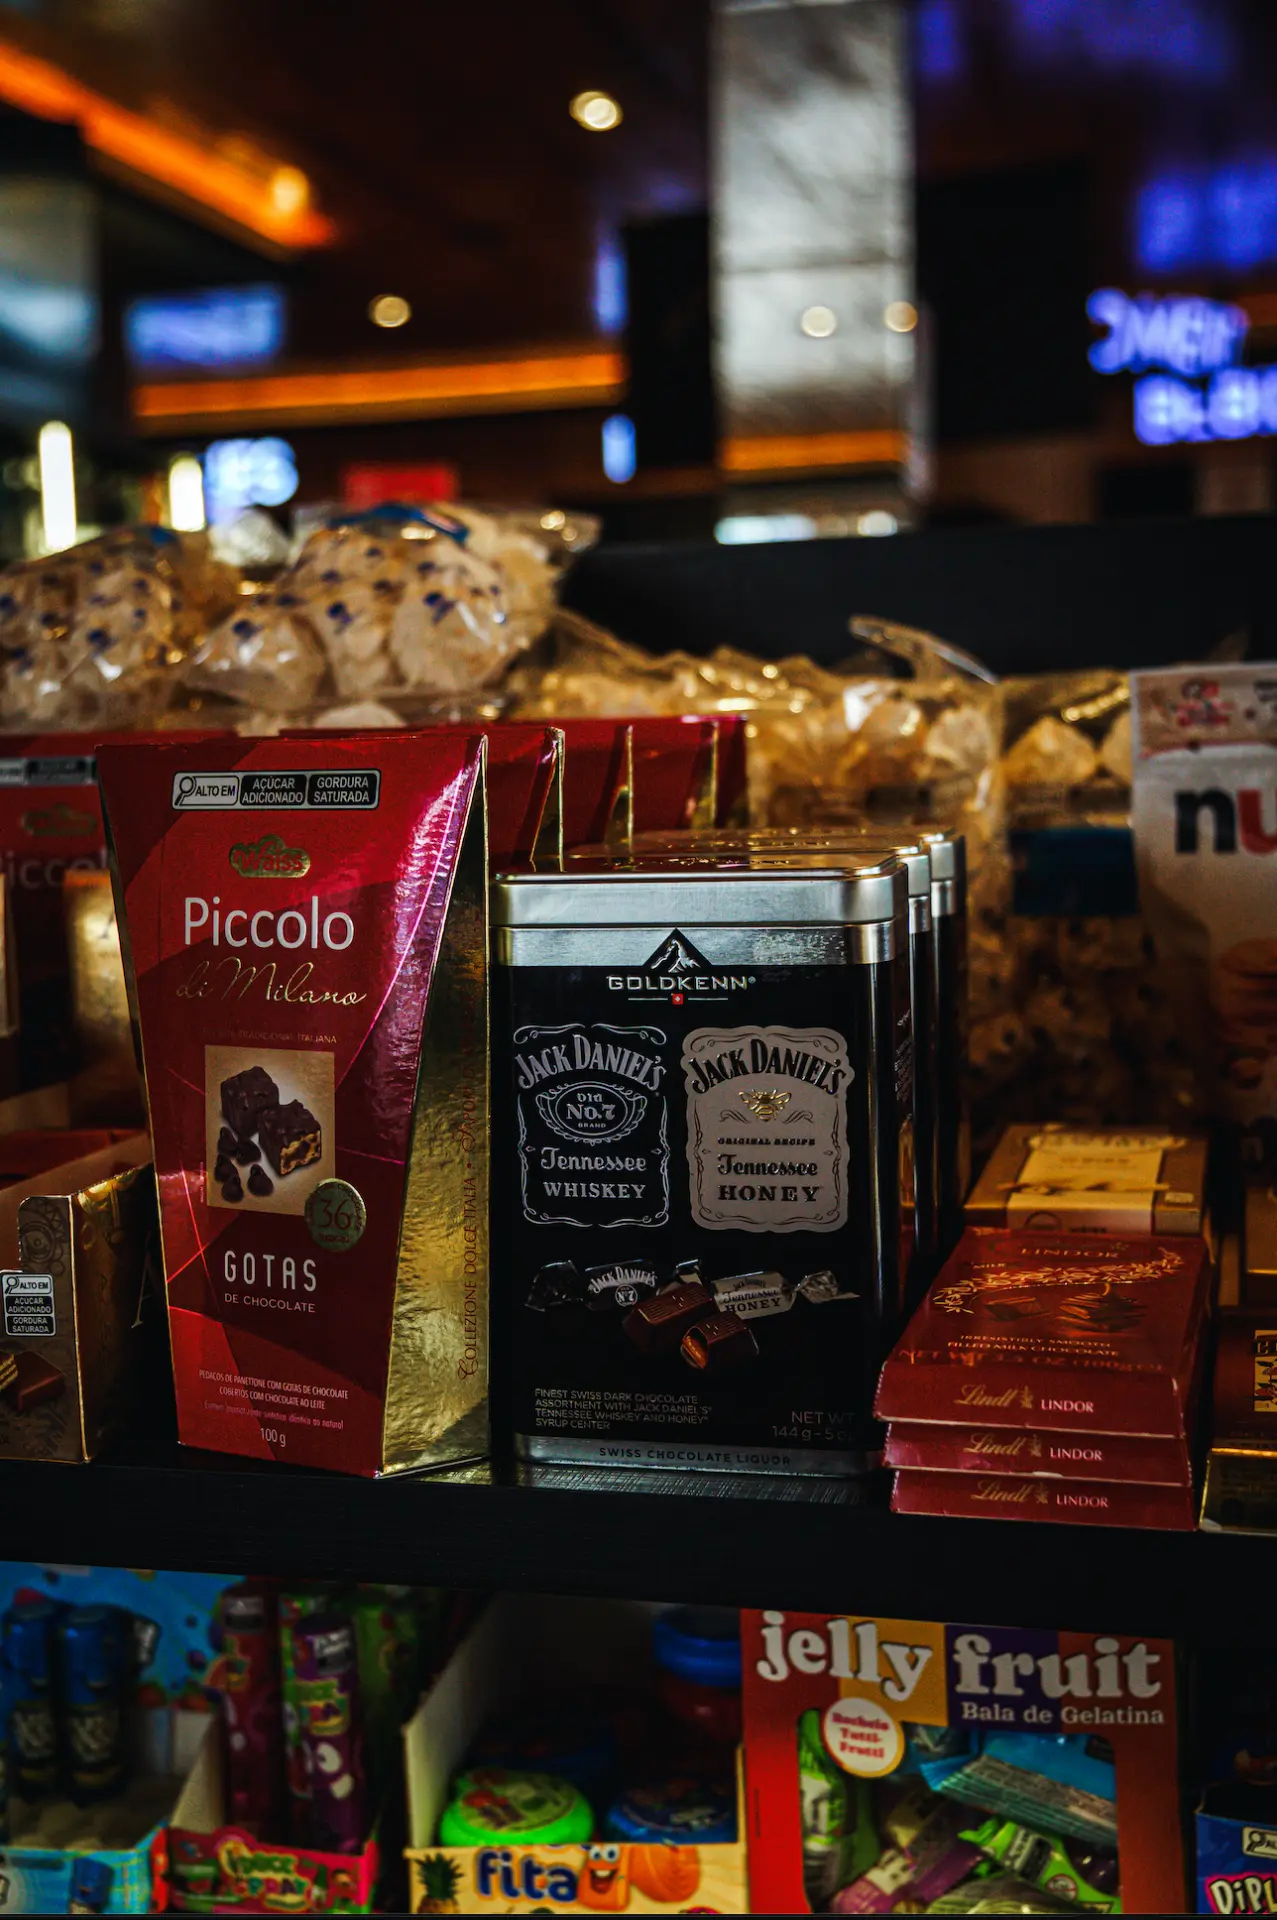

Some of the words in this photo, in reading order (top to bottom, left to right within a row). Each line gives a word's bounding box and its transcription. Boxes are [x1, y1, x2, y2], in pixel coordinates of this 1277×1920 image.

[195, 786, 219, 796] ALTO
[221, 785, 235, 796] EM
[253, 775, 295, 792] AÇÚCAR
[317, 776, 369, 789] GORDURA
[242, 792, 304, 803] ADICIONADO
[313, 791, 369, 803] SATURADA
[232, 840, 302, 872] Waiss
[184, 895, 354, 950] Piccolo
[176, 960, 214, 999] di
[217, 956, 367, 1005] Milano
[297, 1032, 337, 1044] ITALIANA
[514, 1044, 574, 1089] JACK
[572, 1033, 667, 1093] DANIEL'S
[688, 1048, 750, 1094] JACK
[750, 1038, 846, 1095] DANIEL'S
[718, 1138, 771, 1146] ORIGINAL
[774, 1138, 816, 1146] RECIPE
[540, 1147, 647, 1171] Tennessee
[717, 1154, 818, 1176] Tennessee
[463, 1177, 477, 1222] ITALIA
[543, 1182, 646, 1199] WHISKEY
[718, 1185, 821, 1202] HONEY
[318, 1198, 351, 1230] 36
[463, 1225, 478, 1279] DOLCE
[224, 1250, 317, 1292] GOTAS
[19, 1282, 37, 1290] ALTO
[38, 1281, 49, 1290] EM
[8, 1305, 52, 1314] ADICIONADO
[224, 1293, 239, 1304] DE
[243, 1295, 316, 1314] CHOCOLATE
[724, 1297, 782, 1314] HONEY
[12, 1325, 50, 1333] SATURADA
[13, 1316, 48, 1325] GORDURA
[458, 1285, 479, 1381] COLLEZIONE
[225, 1374, 233, 1383] DE
[234, 1375, 266, 1389] PANETTONE
[267, 1380, 282, 1391] COM
[283, 1382, 302, 1394] GOTAS
[303, 1385, 311, 1394] DE
[312, 1386, 349, 1400] CHOCOLATE
[535, 1388, 568, 1398] FINEST
[571, 1390, 602, 1400] SWISS
[604, 1391, 632, 1401] DARK
[635, 1393, 698, 1405] CHOCOLATE
[219, 1386, 249, 1399] COBERTOS
[250, 1390, 264, 1401] COM
[265, 1392, 299, 1406] CHOCOLATE
[300, 1397, 309, 1407] AO
[310, 1399, 325, 1410] LEITE
[535, 1399, 602, 1410] ASSORTMENT
[604, 1401, 631, 1411] WITH
[633, 1403, 660, 1413] JACK
[953, 1383, 1019, 1409] Lindt
[1040, 1398, 1095, 1413] LINDOR
[322, 1419, 344, 1430] natural
[535, 1408, 593, 1419] TENNESSEE
[595, 1410, 641, 1422] WHISKEY
[643, 1413, 665, 1423] AND
[535, 1418, 568, 1428] SYRUP
[570, 1420, 611, 1430] CENTER
[791, 1410, 825, 1425] NET
[827, 1412, 857, 1425] WT
[260, 1427, 279, 1443] 100
[280, 1433, 287, 1448] g
[963, 1432, 1027, 1457] Lindt
[1049, 1447, 1103, 1462] LINDOR
[599, 1446, 641, 1458] SWISS
[647, 1449, 731, 1463] CHOCOLATE
[737, 1454, 790, 1466] LIQUOR
[970, 1478, 1033, 1504] Lindt
[1056, 1493, 1109, 1508] LINDOR
[756, 1610, 933, 1701] jelly
[953, 1632, 1162, 1699] fruit
[960, 1700, 1016, 1722] Bala
[1022, 1704, 1054, 1724] de
[1060, 1705, 1165, 1725] Gelatina
[839, 1744, 884, 1758] Frutti
[476, 1848, 578, 1902] fita
